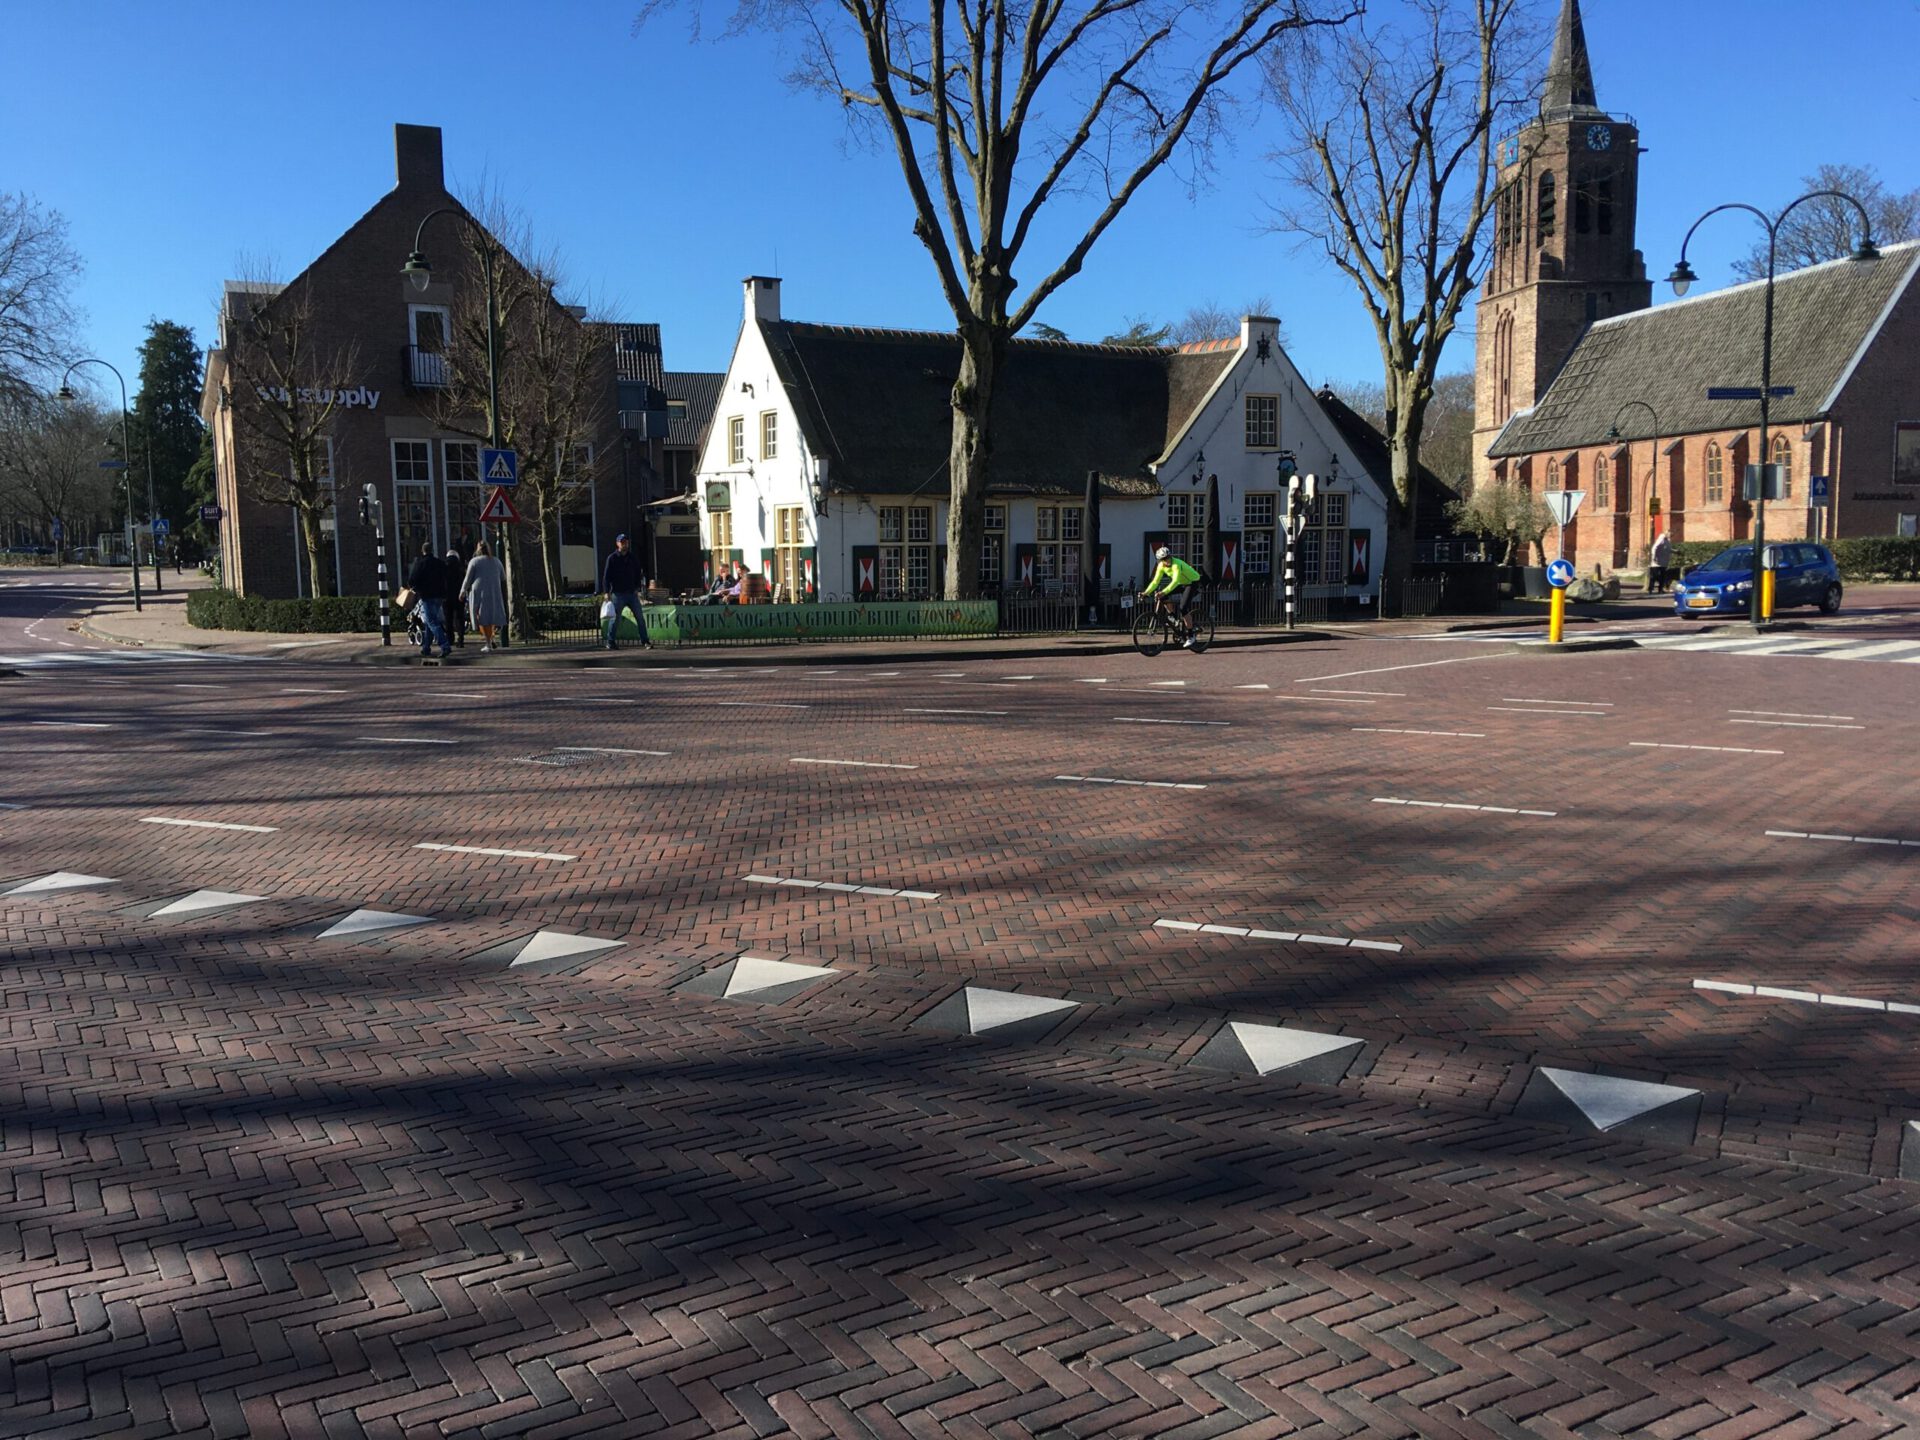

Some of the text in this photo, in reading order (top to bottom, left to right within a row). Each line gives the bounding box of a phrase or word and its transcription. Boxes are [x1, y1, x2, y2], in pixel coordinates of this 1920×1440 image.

[644, 612, 671, 629] IEVE
[736, 611, 763, 628] NOG
[768, 611, 800, 628] EVEN
